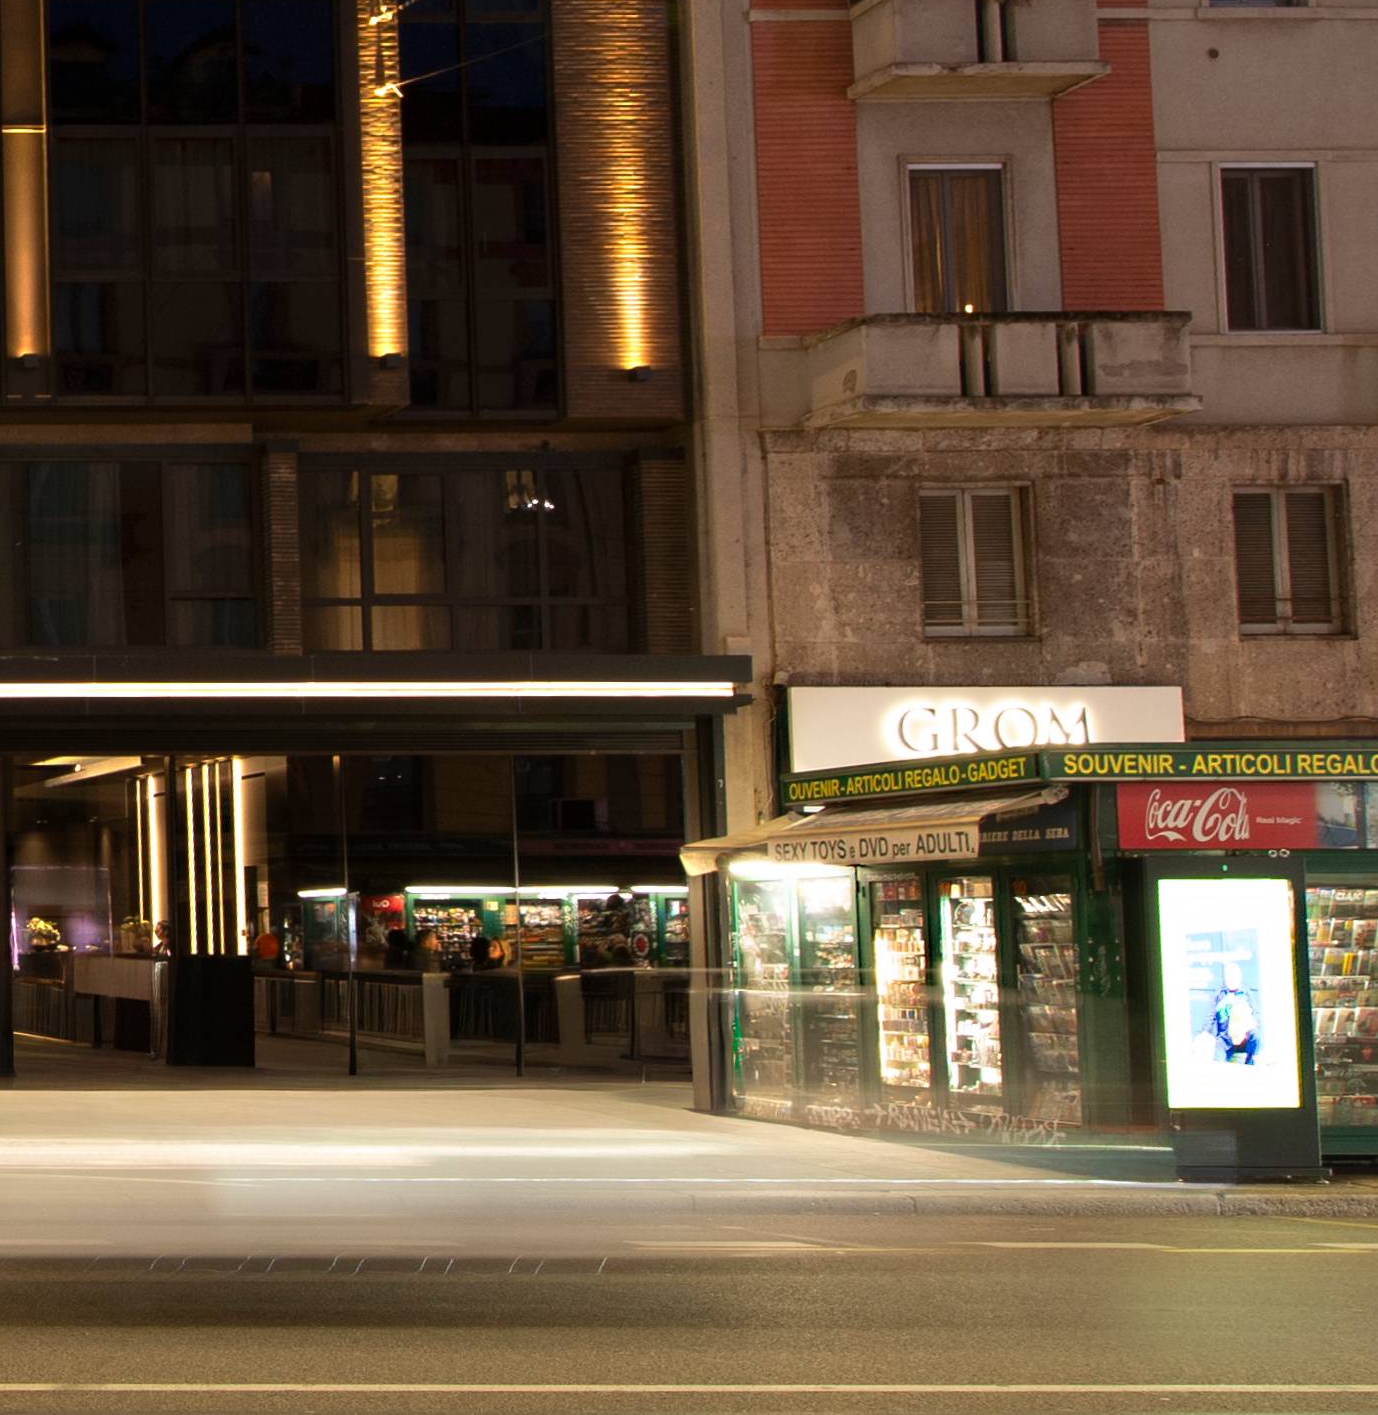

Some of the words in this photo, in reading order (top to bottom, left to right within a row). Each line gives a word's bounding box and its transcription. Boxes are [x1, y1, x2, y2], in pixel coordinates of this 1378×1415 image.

[898, 706, 1091, 752] GROM
[846, 772, 902, 795] ARTICOLI
[905, 764, 960, 789] REGALO
[967, 757, 1026, 782] GADGET
[1063, 754, 1174, 774] SOUVENIR
[1192, 754, 1291, 774] ARTICOLI
[1145, 787, 1251, 842] Coca-Cola
[775, 841, 807, 862] SEXY
[810, 839, 847, 860] TOYS
[849, 845, 856, 859] e
[859, 836, 889, 858] DVD
[892, 841, 911, 859] per
